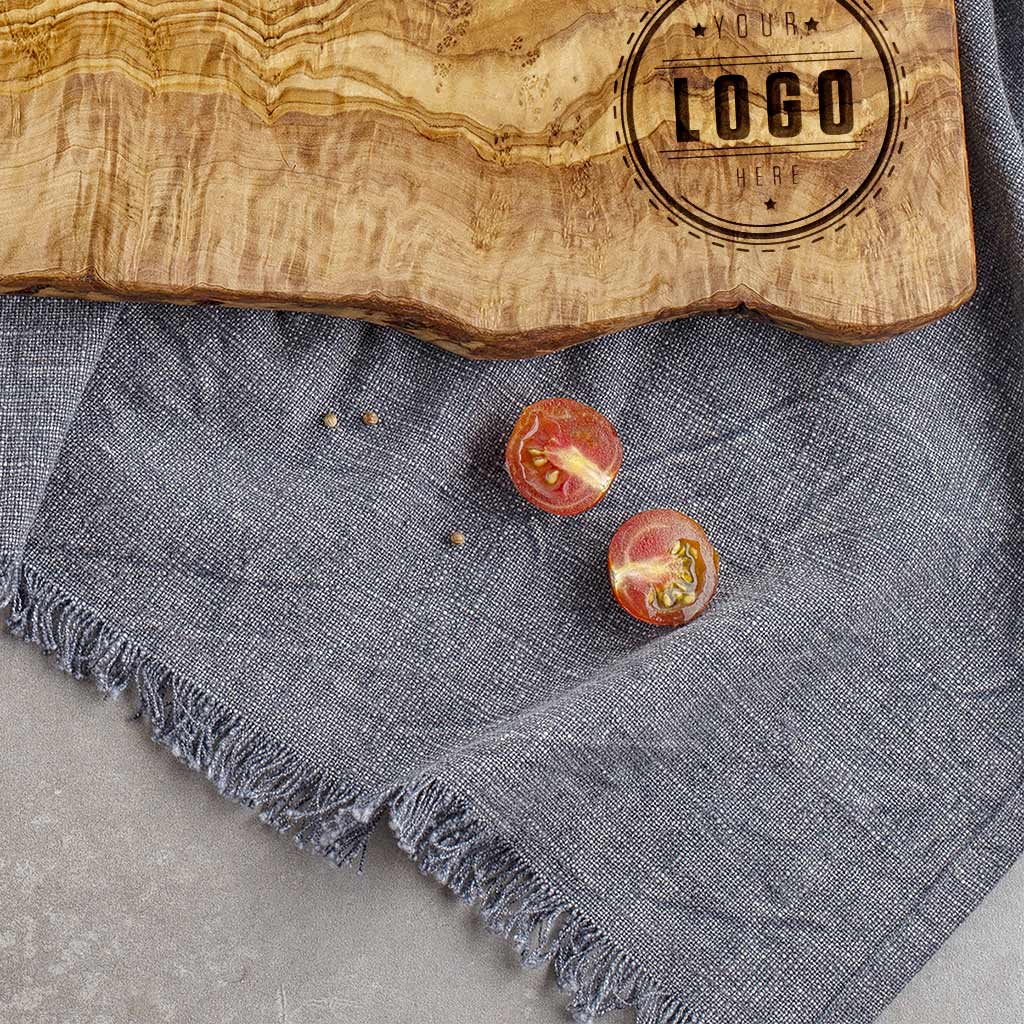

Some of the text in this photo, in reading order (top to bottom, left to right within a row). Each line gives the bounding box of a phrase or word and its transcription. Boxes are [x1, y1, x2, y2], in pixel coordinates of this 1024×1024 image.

[713, 11, 797, 39] YOUR
[673, 68, 855, 143] LOGO
[736, 164, 800, 188] HERE
